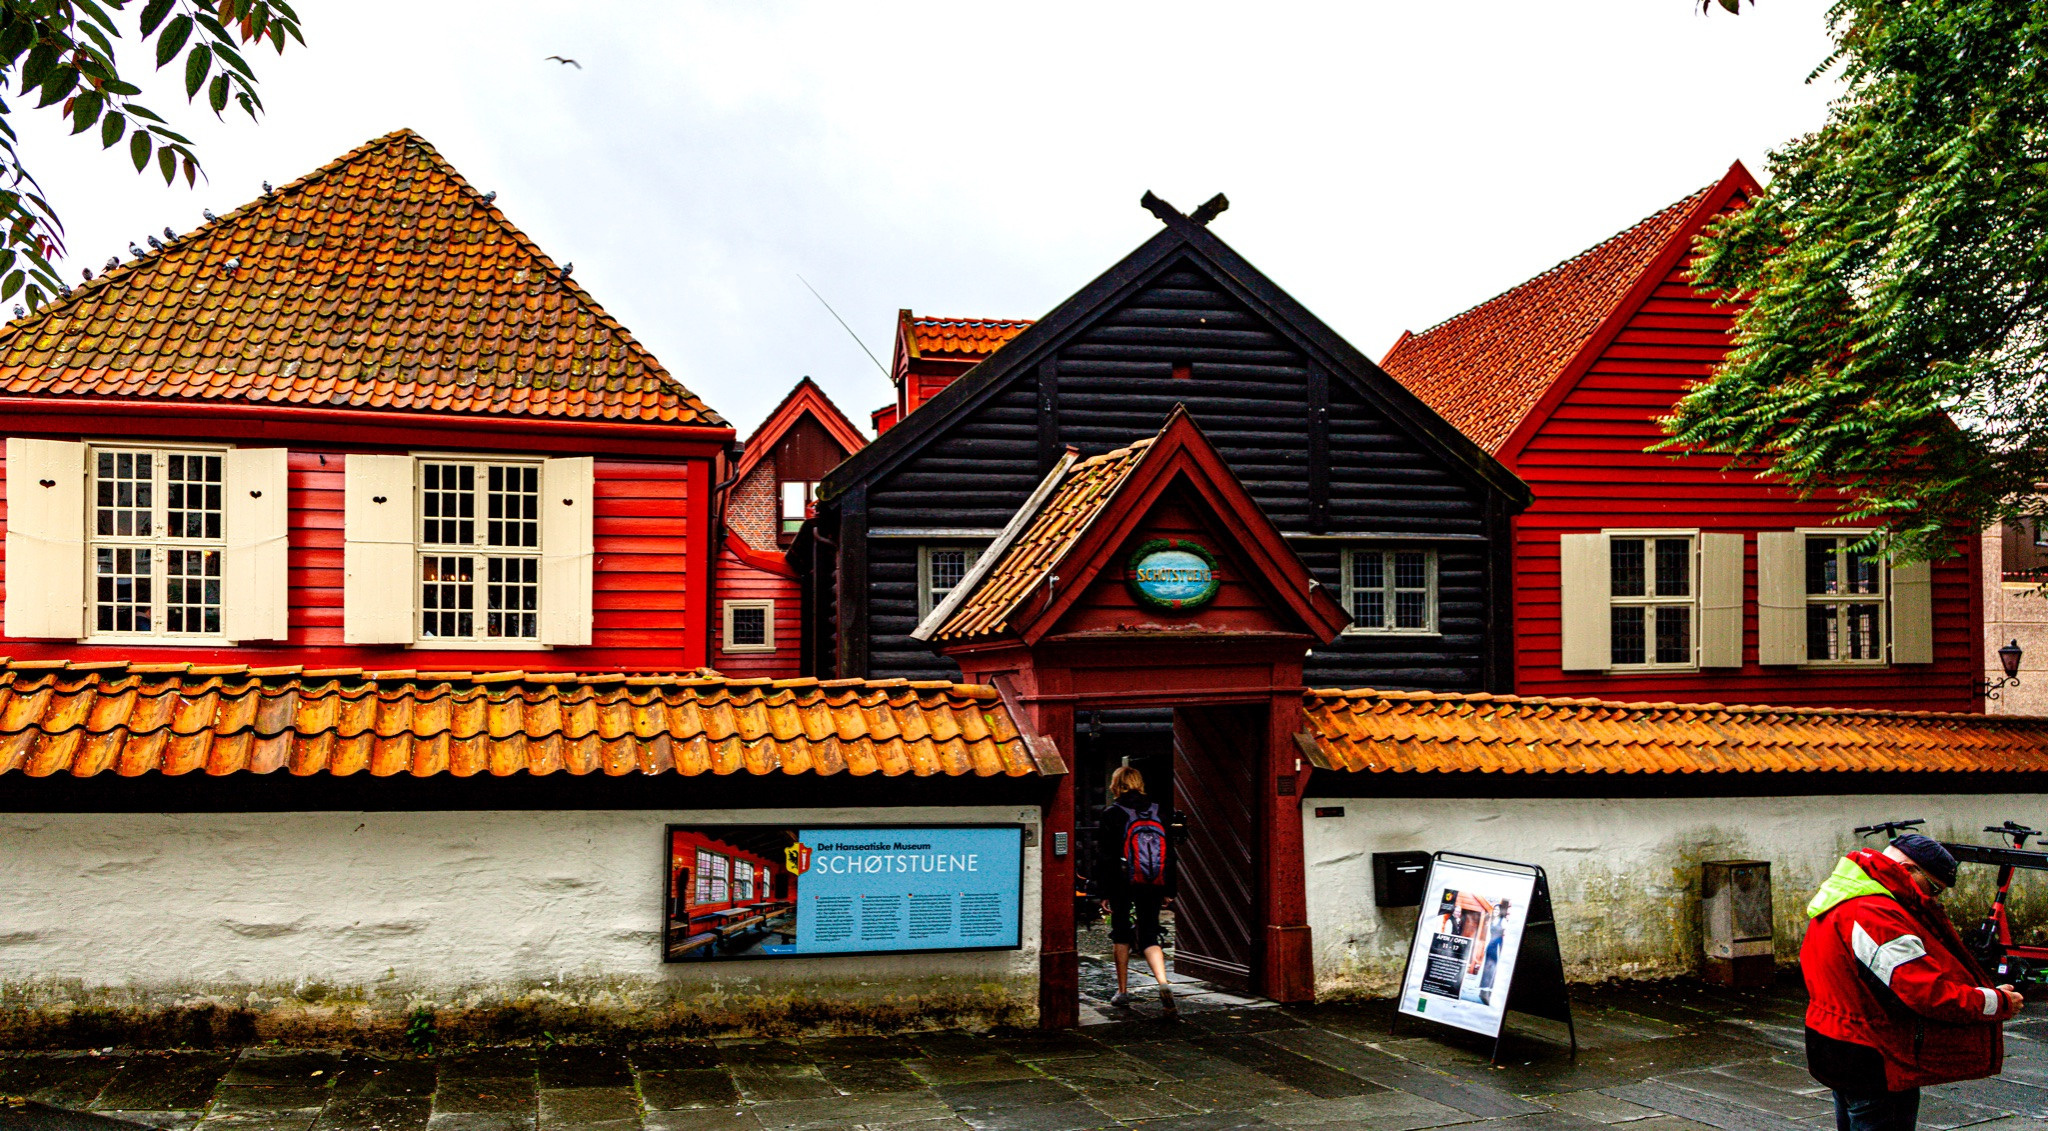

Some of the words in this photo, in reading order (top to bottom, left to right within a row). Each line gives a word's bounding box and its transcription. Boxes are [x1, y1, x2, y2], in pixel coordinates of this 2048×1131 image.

[818, 843, 833, 851] Det
[836, 842, 891, 851] Hanseatiske
[893, 842, 931, 850] Museum
[816, 854, 978, 874] SCHØTSTUENE
[1454, 937, 1468, 945] OPEN
